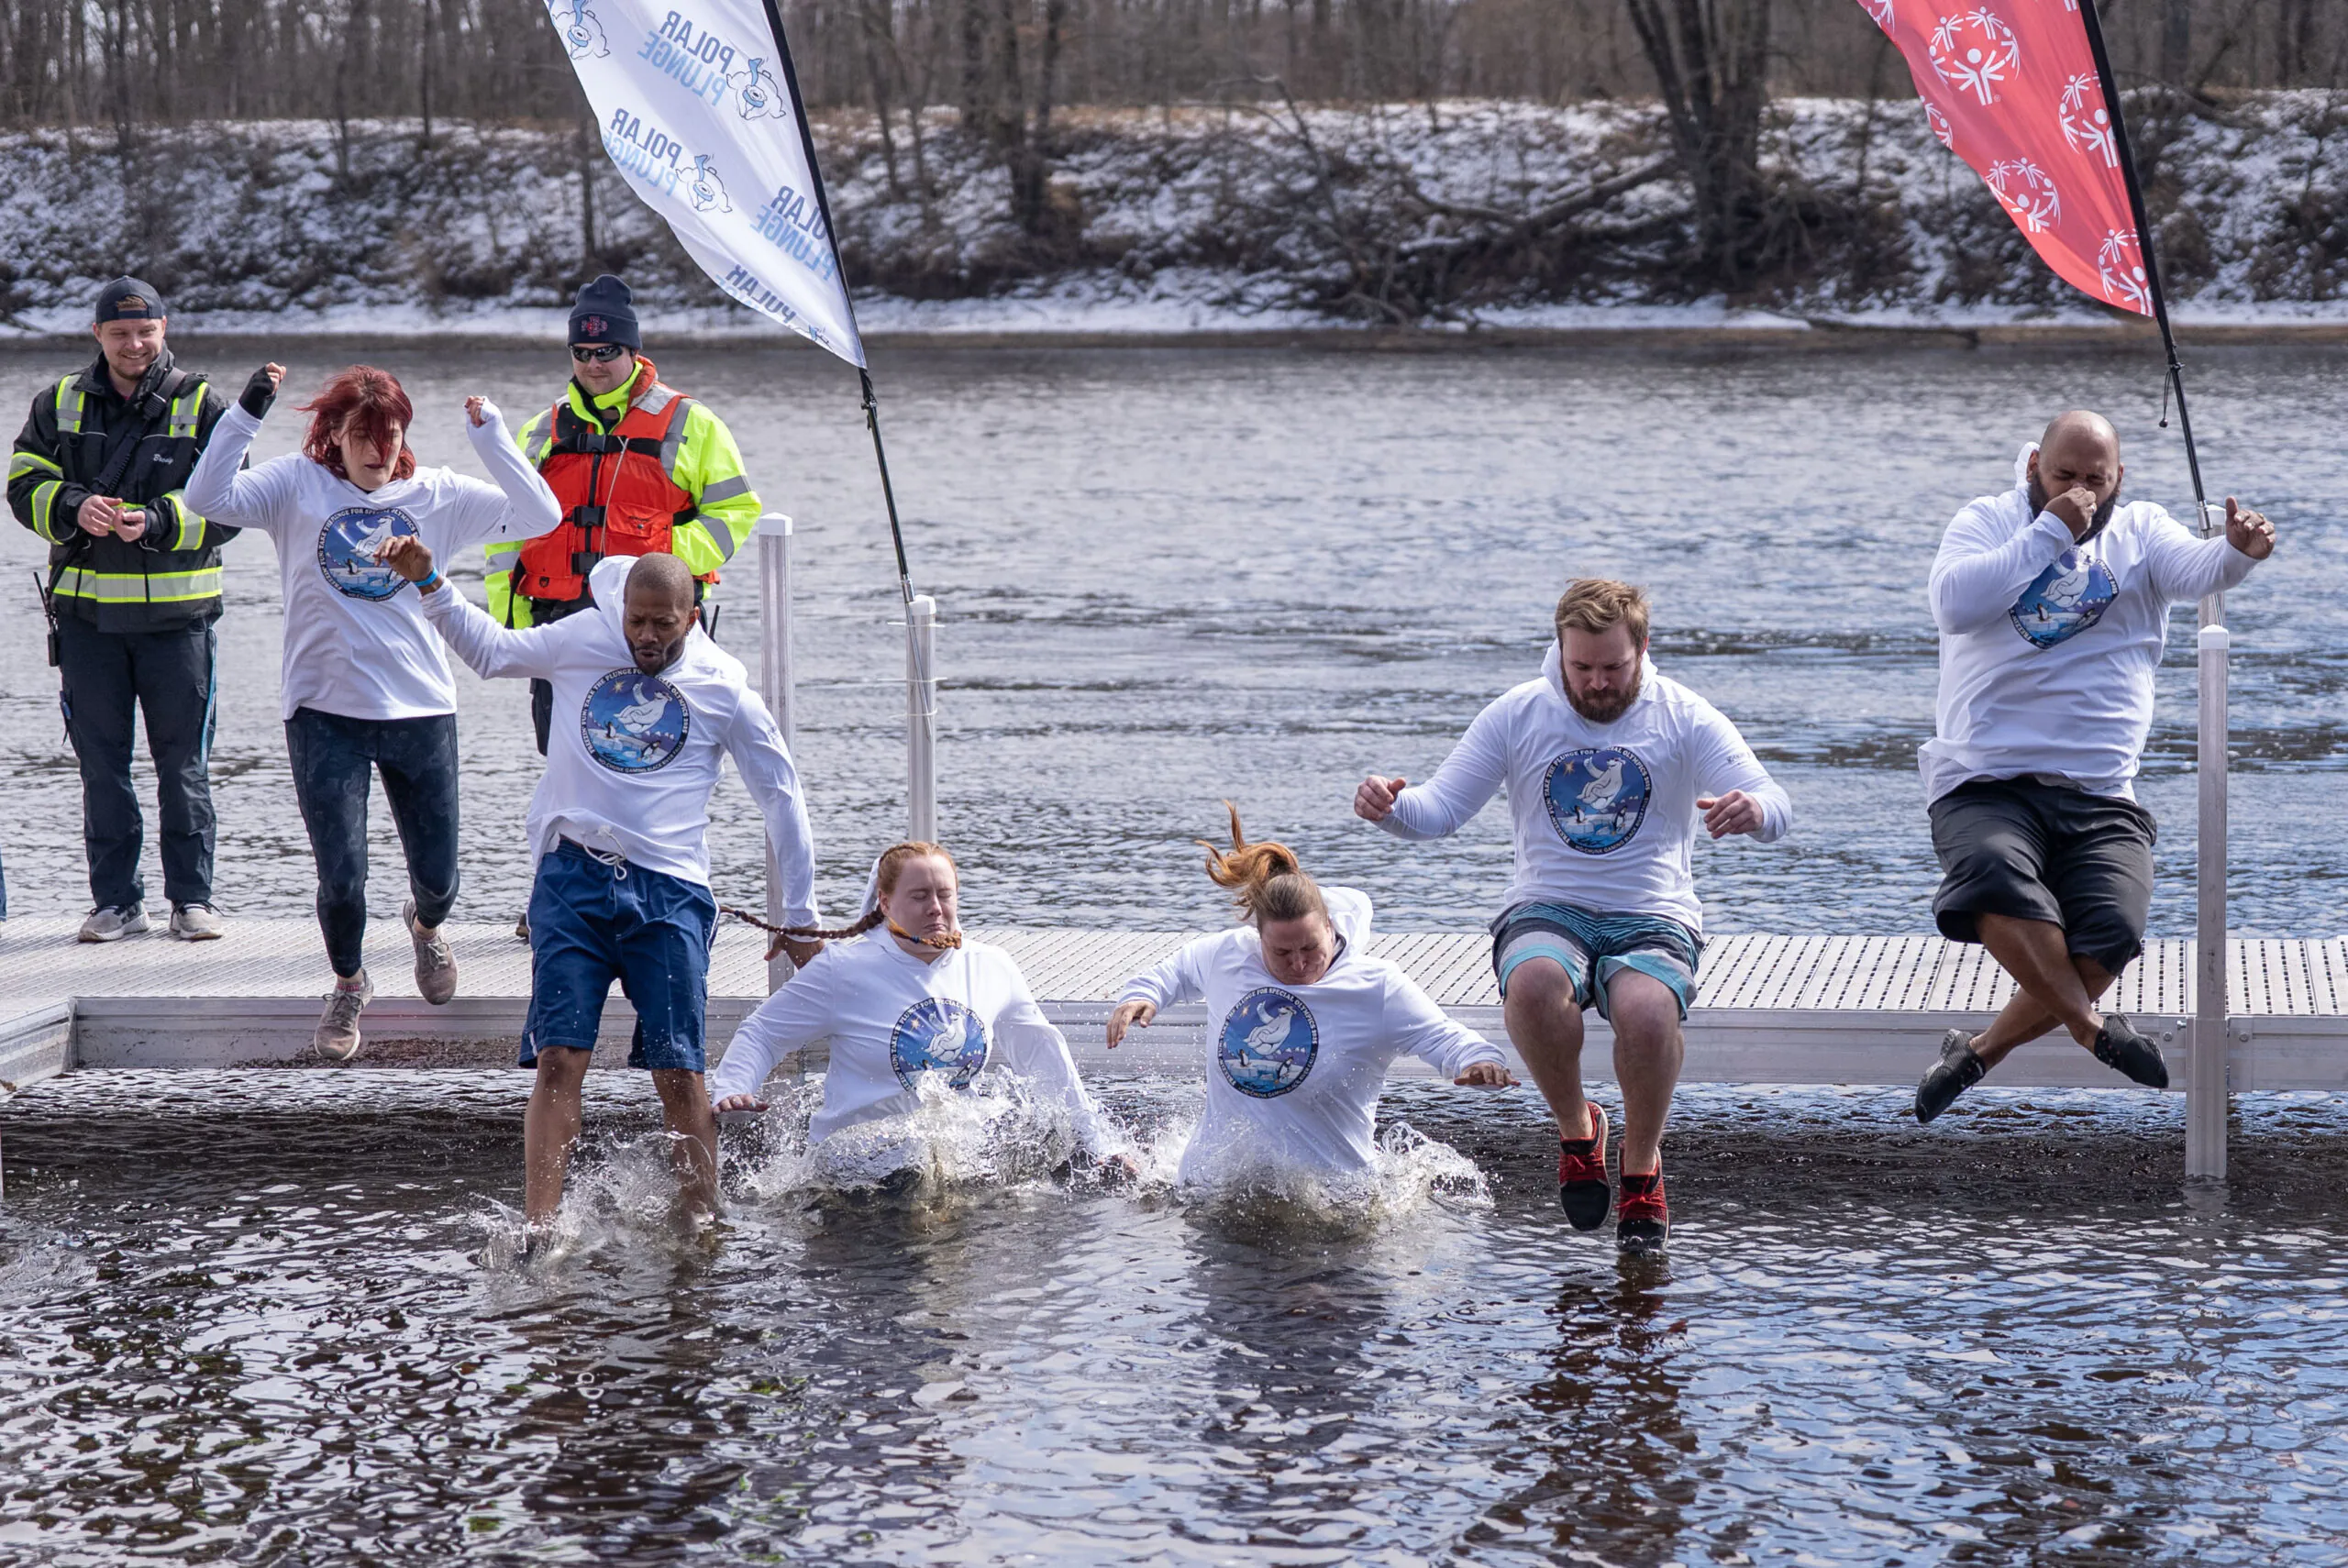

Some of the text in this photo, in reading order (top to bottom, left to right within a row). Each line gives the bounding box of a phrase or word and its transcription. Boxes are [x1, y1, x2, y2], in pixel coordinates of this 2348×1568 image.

[318, 531, 327, 548] TAKE
[583, 690, 595, 706] TAKE
[593, 678, 604, 690] THE
[604, 668, 631, 680] PLUNGE
[670, 687, 688, 716] OLYMPICS
[1546, 764, 1556, 778] THE
[1553, 749, 1578, 766] PLUNGE
[1622, 749, 1648, 776] OLYMPICS
[1603, 839, 1624, 851] GAMING
[1268, 988, 1295, 1001] SPECIAL
[1293, 999, 1315, 1029] OLYMPICS
